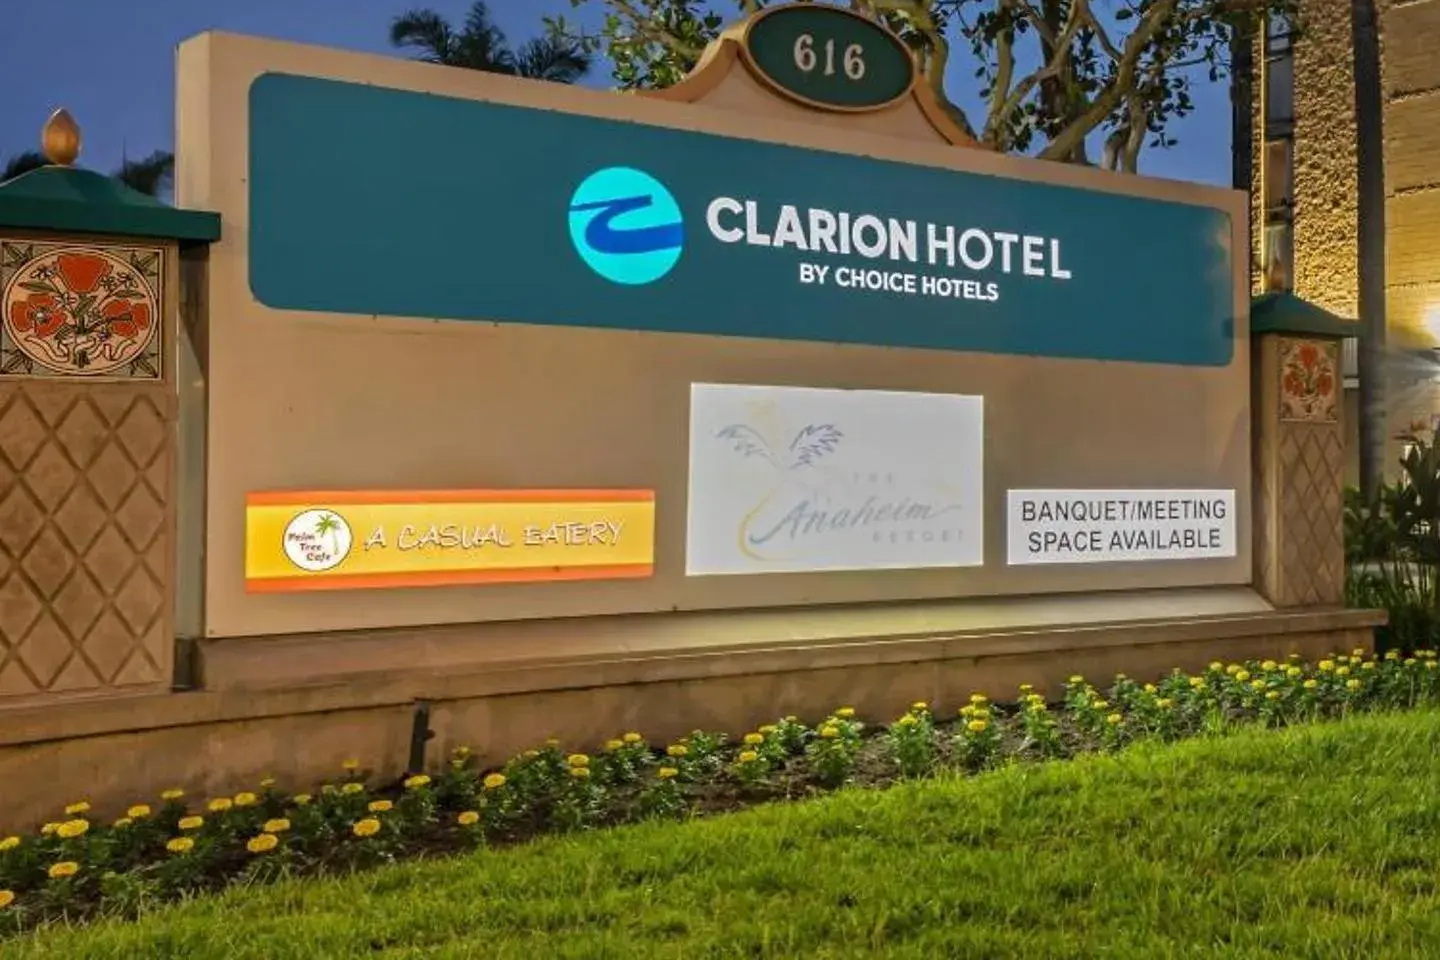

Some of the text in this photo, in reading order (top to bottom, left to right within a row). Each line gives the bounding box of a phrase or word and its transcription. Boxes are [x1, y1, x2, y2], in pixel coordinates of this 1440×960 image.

[793, 33, 866, 81] 616
[706, 197, 1073, 280] CLARION HOTEL
[799, 263, 1000, 302] BY CHOICE HOTELS
[748, 494, 963, 544] Anaheim
[1021, 499, 1226, 522] BANQUET/MEETING
[397, 523, 515, 550] CASUAL
[523, 520, 623, 548] EATERY
[1028, 528, 1221, 553] SPACE AVAILABLE
